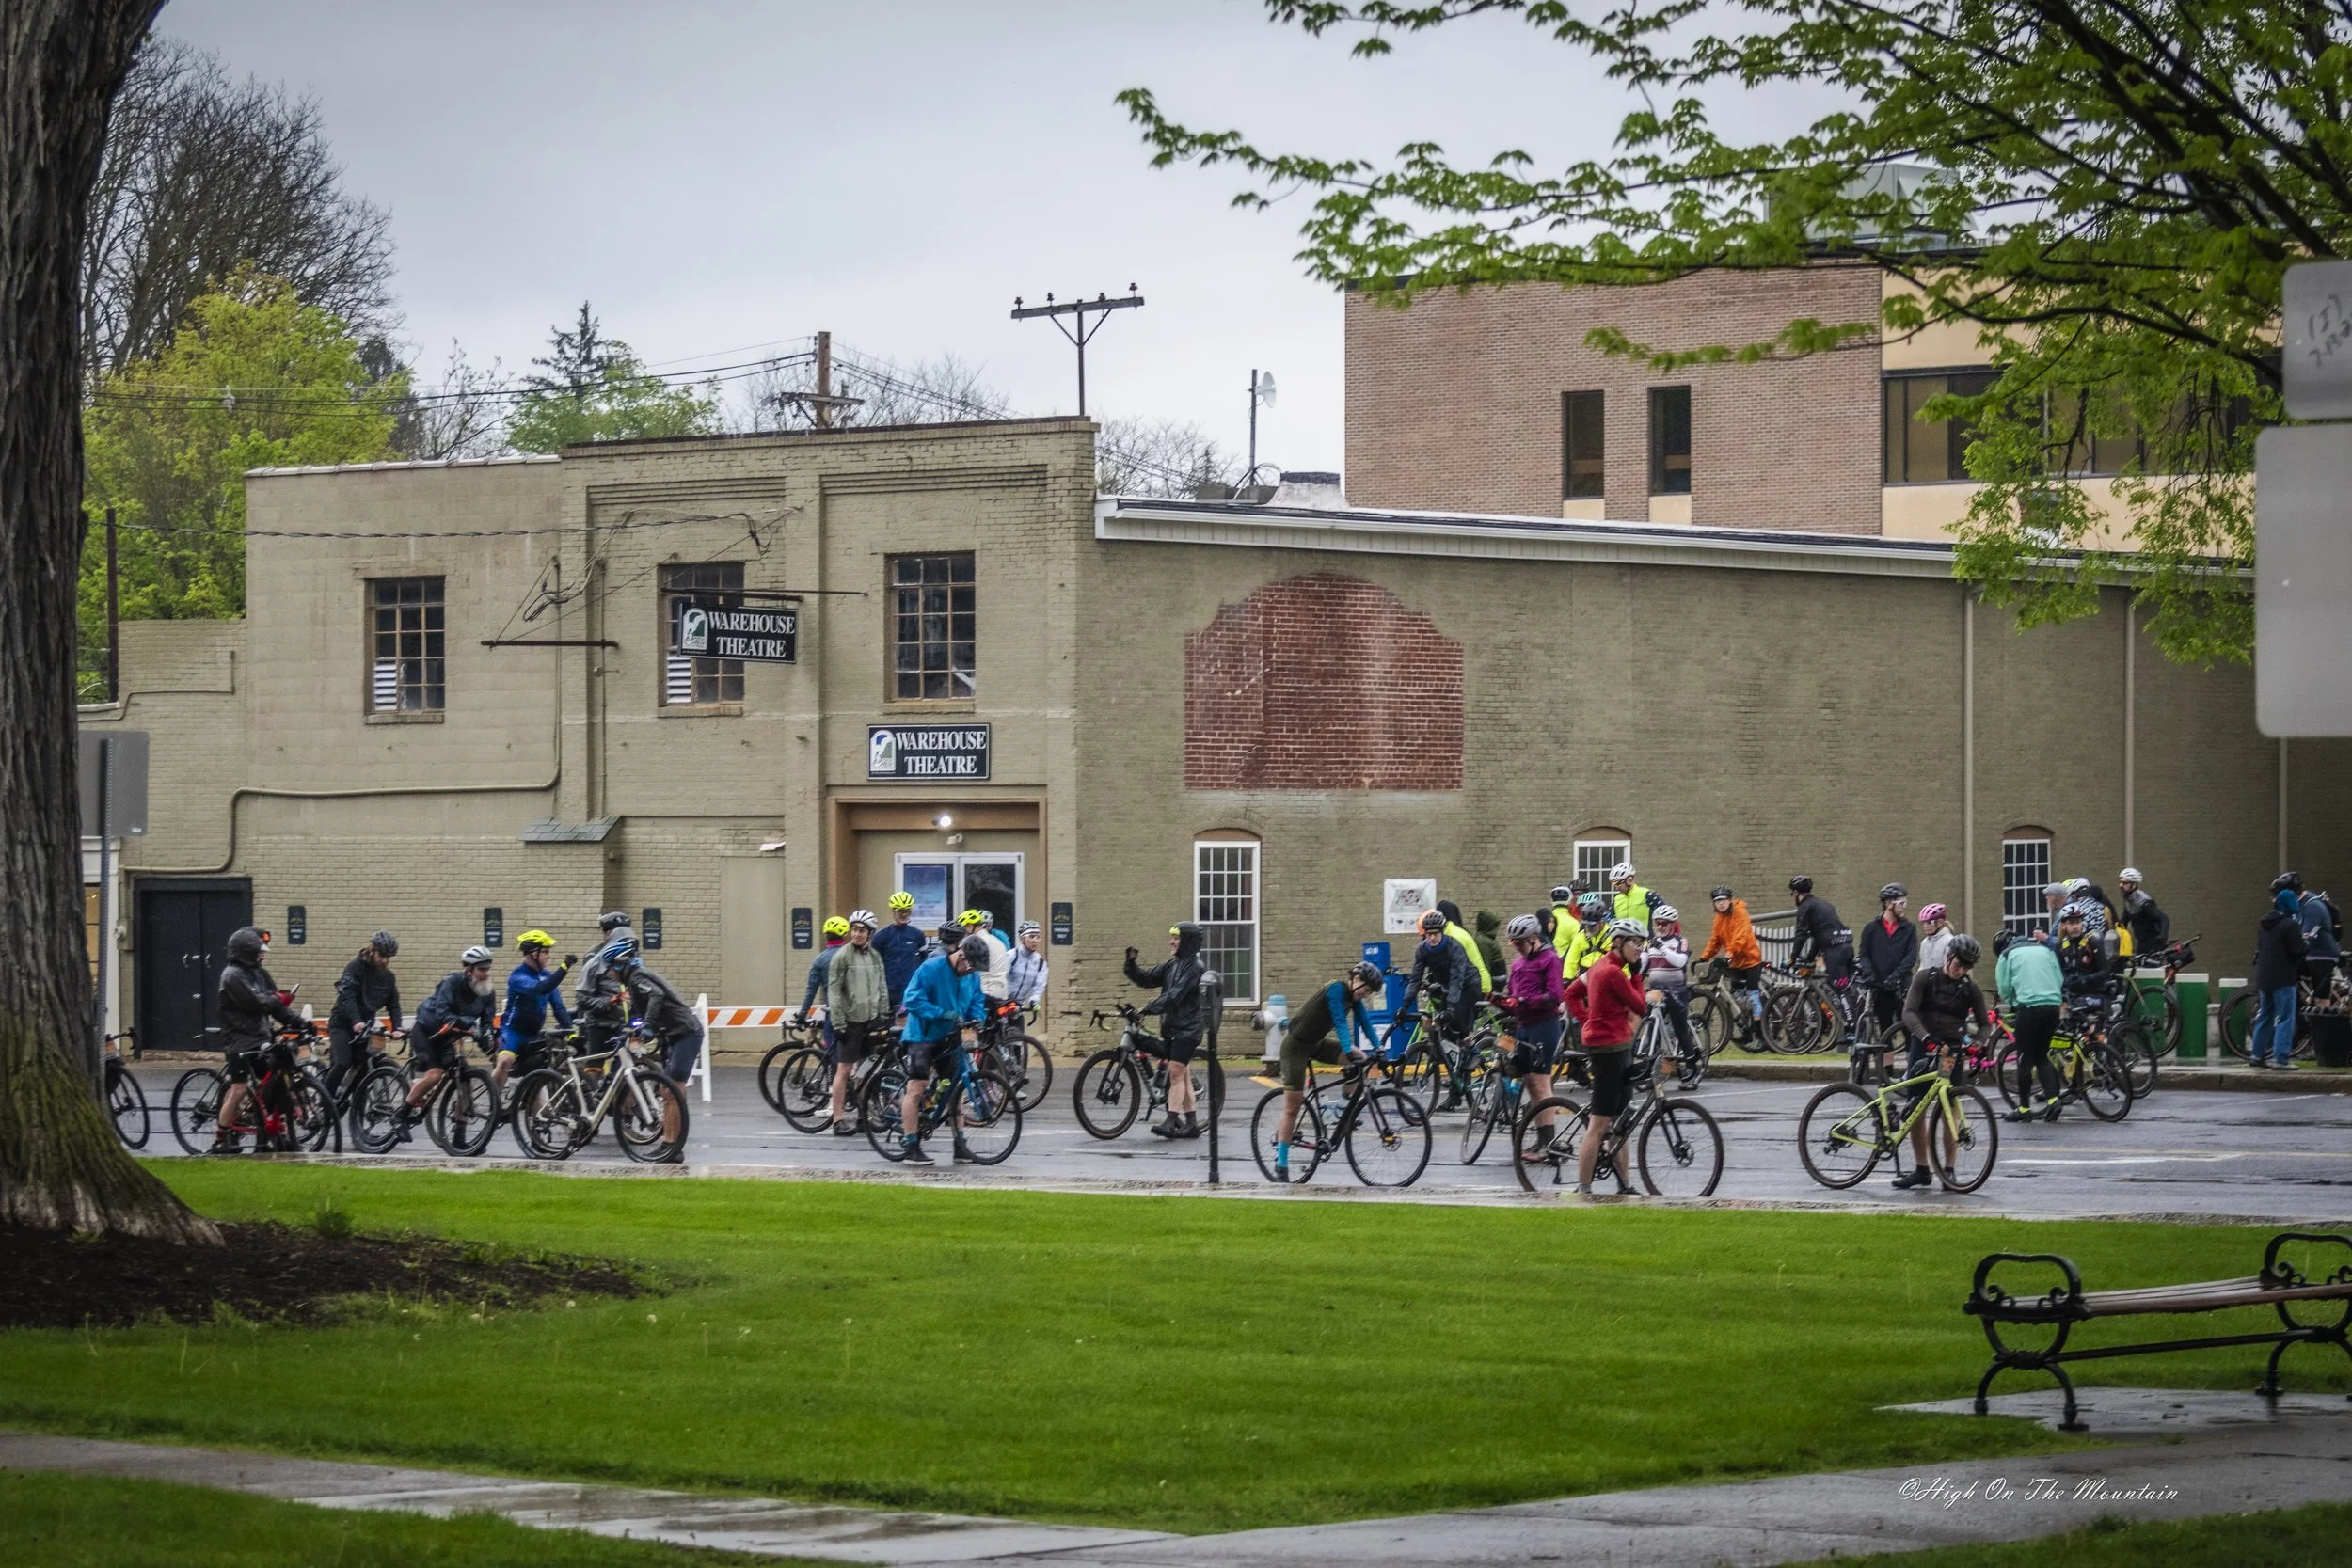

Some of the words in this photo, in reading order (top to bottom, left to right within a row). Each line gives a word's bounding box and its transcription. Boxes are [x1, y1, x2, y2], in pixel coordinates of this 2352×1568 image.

[708, 611, 795, 634] WAREHOUSE
[716, 636, 787, 657] THEATRE
[896, 731, 986, 750] WAREHOUSE
[904, 755, 977, 774] THEATRE
